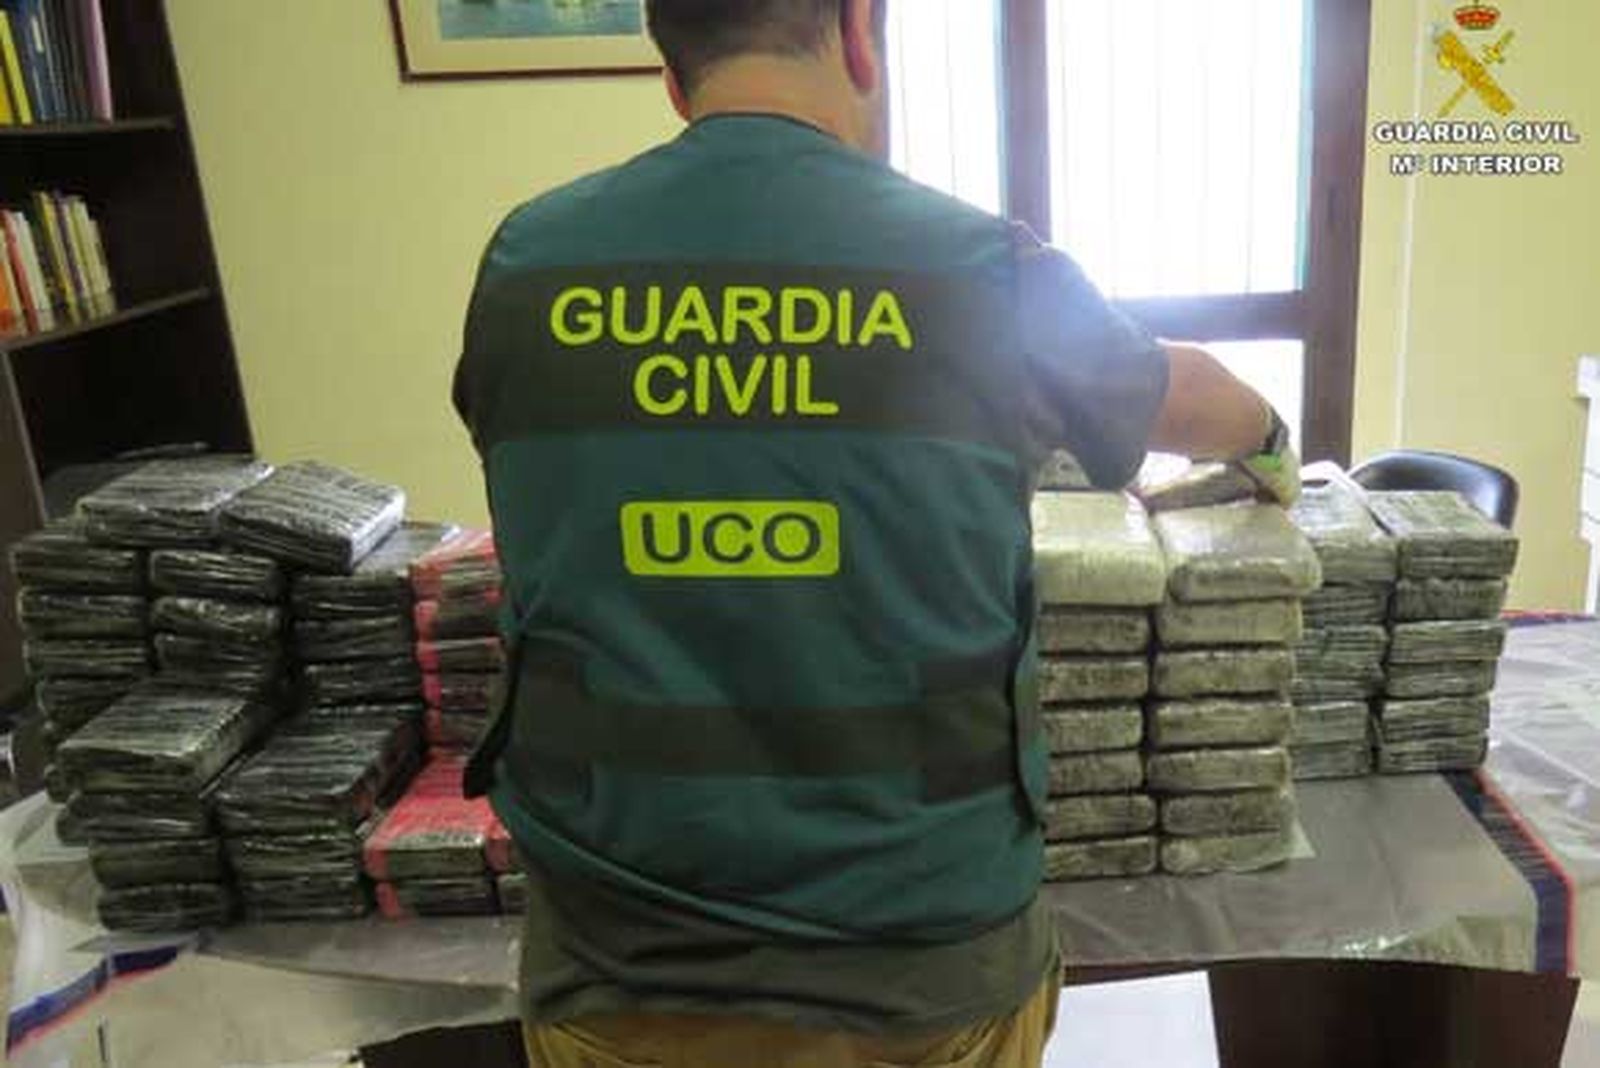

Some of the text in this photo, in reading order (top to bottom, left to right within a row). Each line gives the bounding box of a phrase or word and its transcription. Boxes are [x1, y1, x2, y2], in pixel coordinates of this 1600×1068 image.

[550, 286, 912, 349] GUARDIA
[633, 353, 840, 416] CIVIL
[641, 512, 822, 564] UCO
